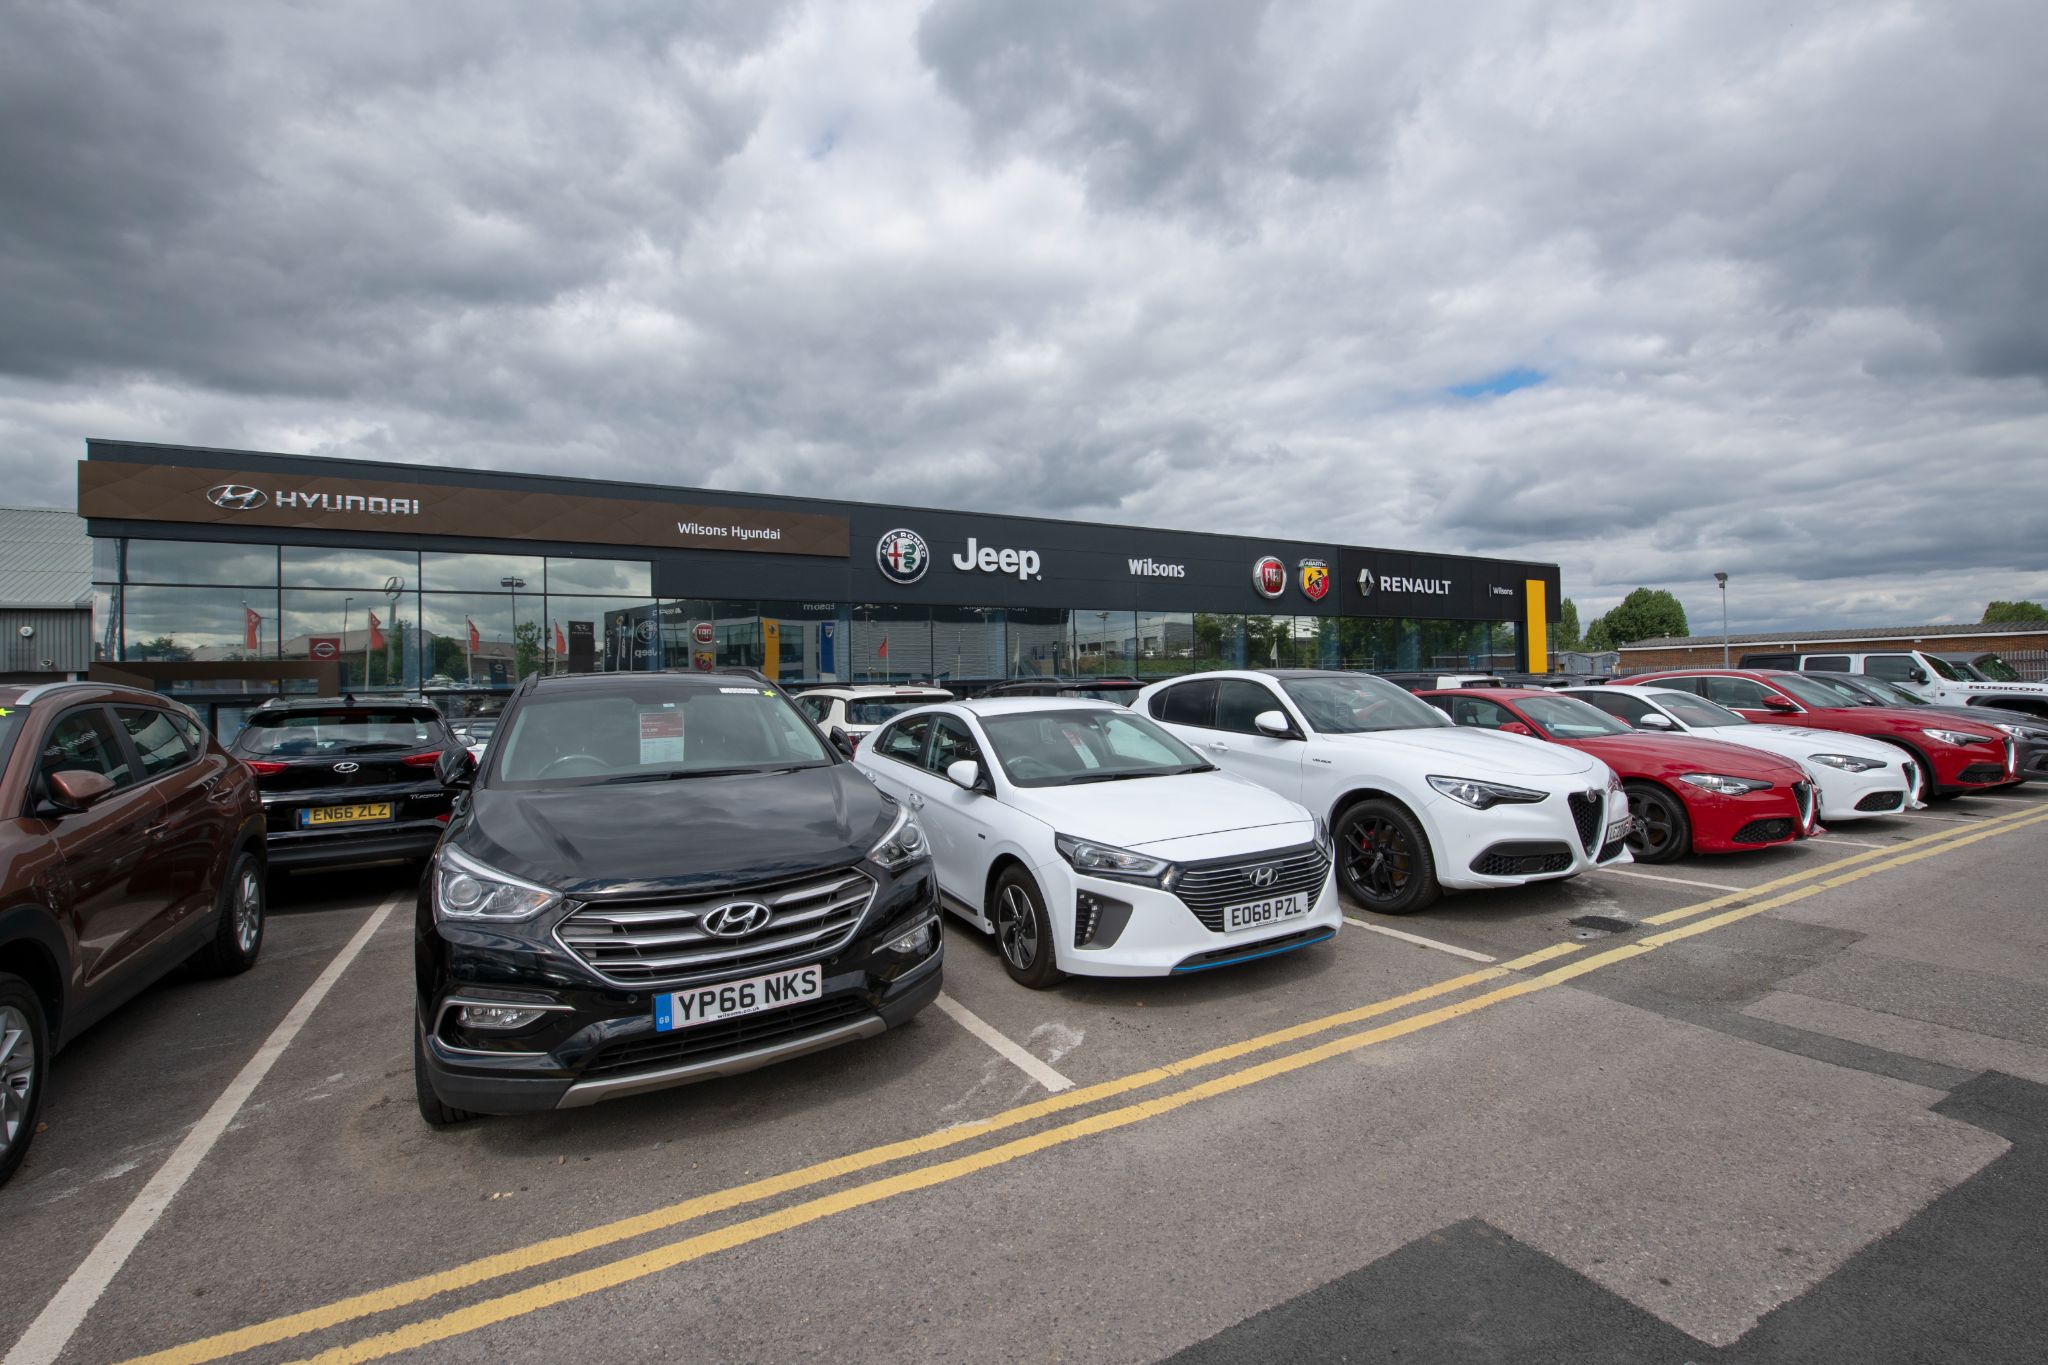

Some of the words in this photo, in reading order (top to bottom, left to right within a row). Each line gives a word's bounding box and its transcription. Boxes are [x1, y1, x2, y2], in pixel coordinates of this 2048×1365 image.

[276, 491, 419, 514] HYUNDAI
[678, 522, 728, 536] Wilsons
[731, 526, 781, 540] Hyundai
[881, 534, 898, 556] ALFA
[900, 532, 926, 558] ROMEO
[953, 538, 1041, 580] Jeep
[1128, 558, 1185, 578] Wilsons
[1264, 567, 1282, 586] FIAT
[1380, 575, 1452, 595] RENAULT
[1493, 586, 1514, 595] Wilsons
[313, 806, 353, 821] EN66
[358, 804, 387, 817] ZLZ
[1275, 896, 1302, 918] PZL
[678, 983, 755, 1020] YP66
[764, 970, 817, 1004] NKS
[659, 1015, 670, 1025] GB
